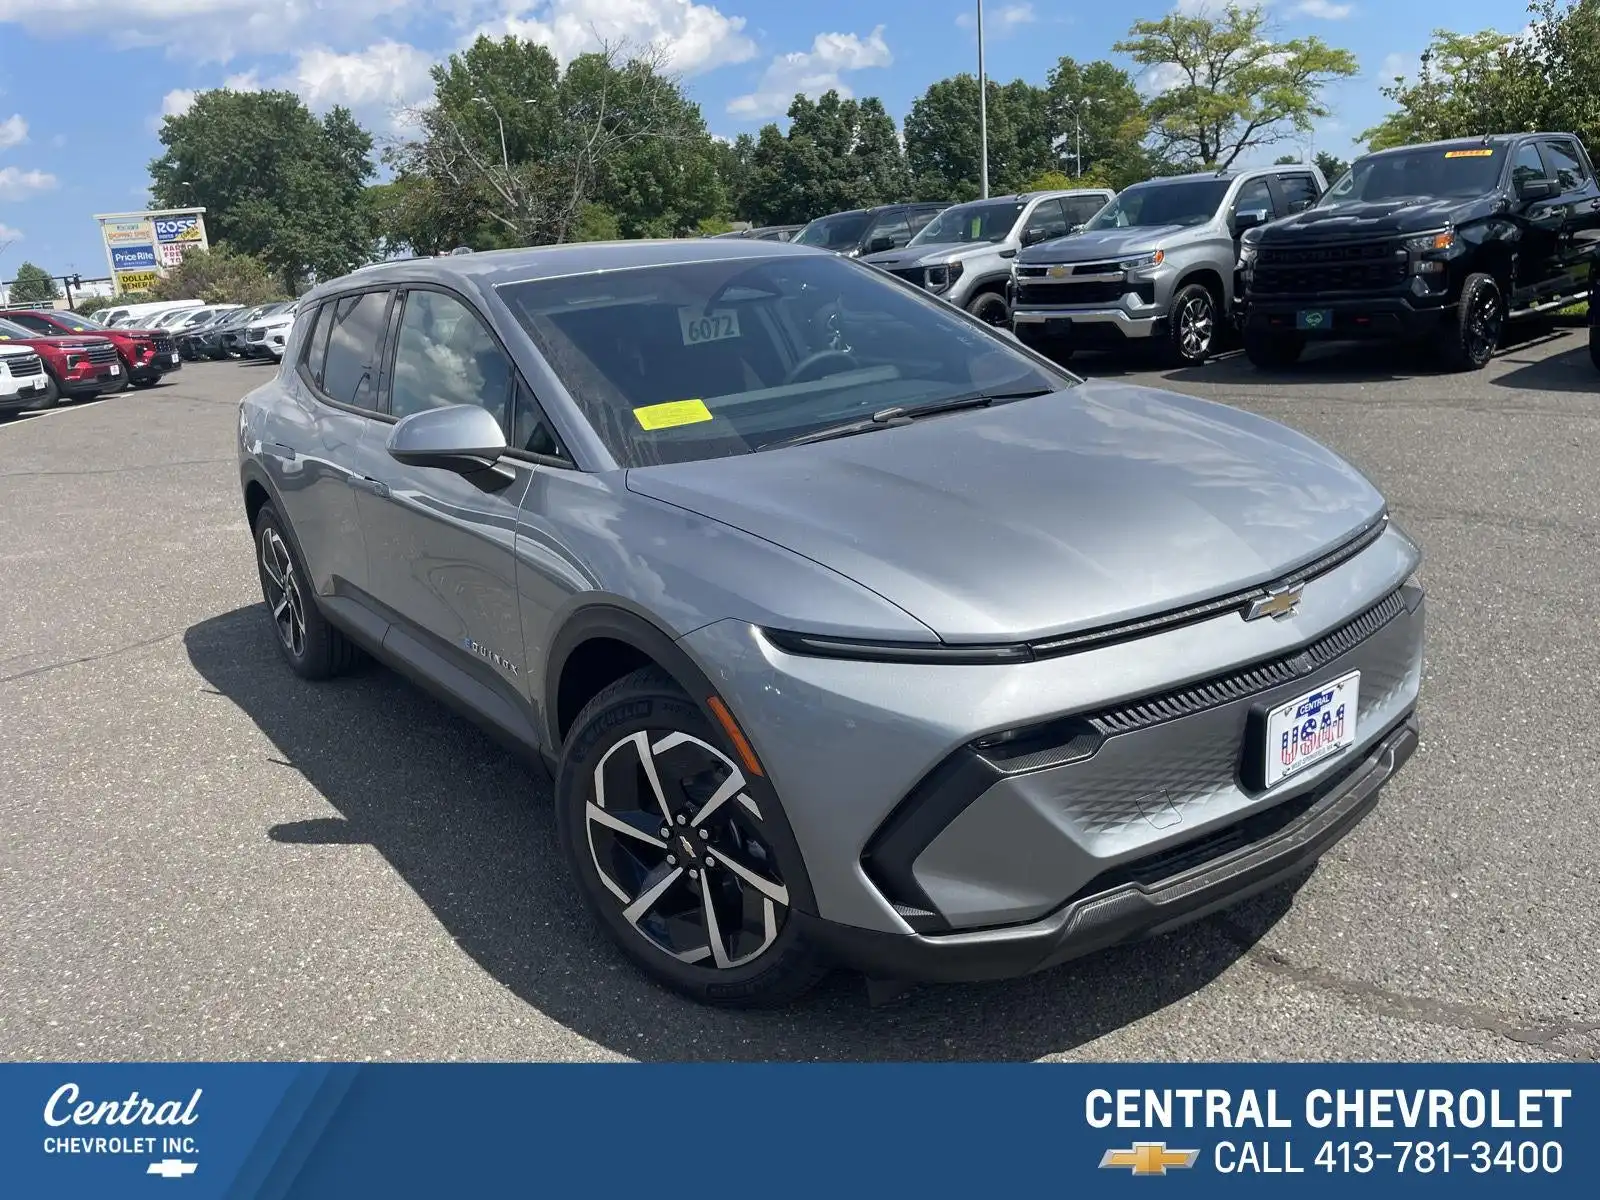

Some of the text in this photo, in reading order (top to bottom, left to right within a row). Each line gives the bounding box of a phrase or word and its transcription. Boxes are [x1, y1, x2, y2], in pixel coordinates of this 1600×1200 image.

[156, 220, 196, 234] ROSS
[122, 274, 154, 282] DOLLAR
[688, 315, 734, 341] 6072
[1299, 695, 1331, 714] CENTRAL
